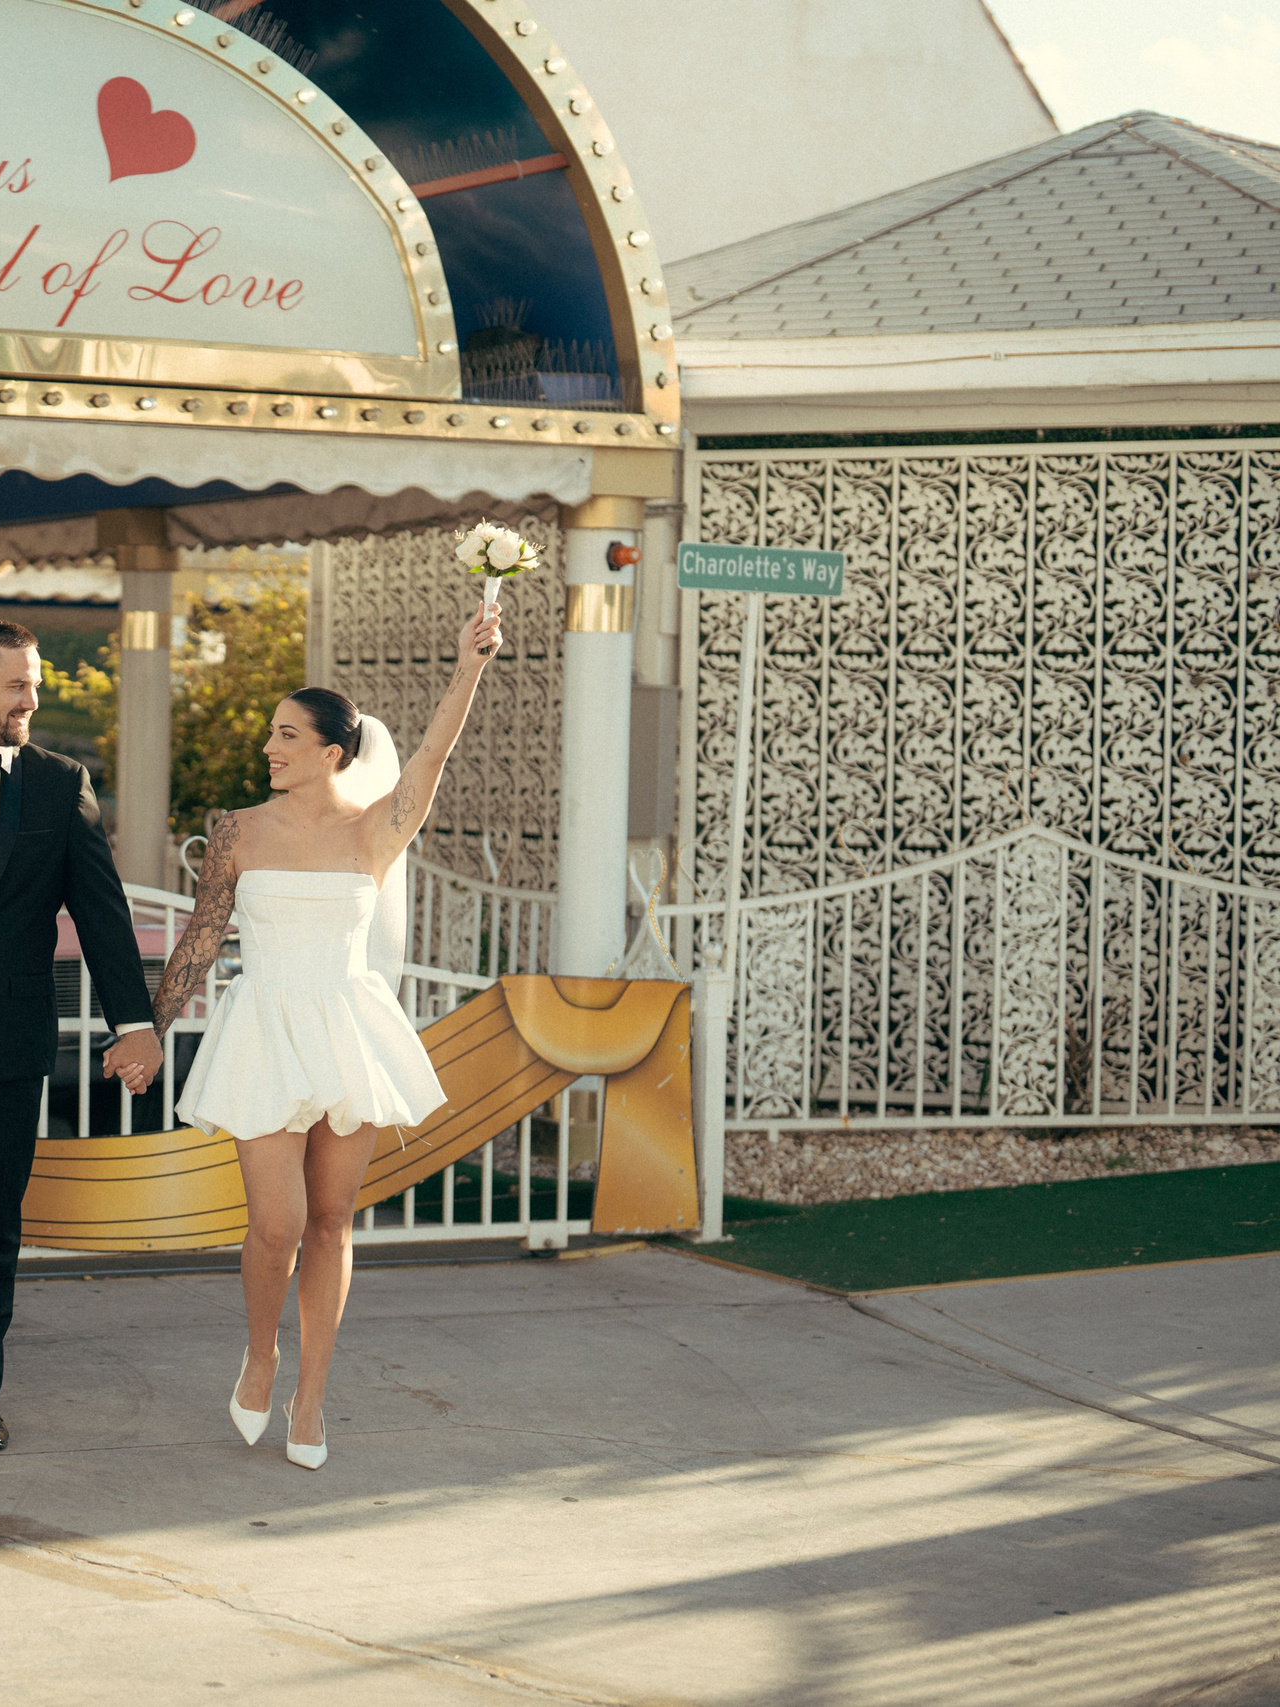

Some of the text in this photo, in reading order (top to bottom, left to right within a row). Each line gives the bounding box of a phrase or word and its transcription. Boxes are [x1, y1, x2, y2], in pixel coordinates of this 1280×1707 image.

[41, 229, 128, 328] of
[128, 219, 305, 311] Love
[682, 551, 839, 590] Charolette's Way
